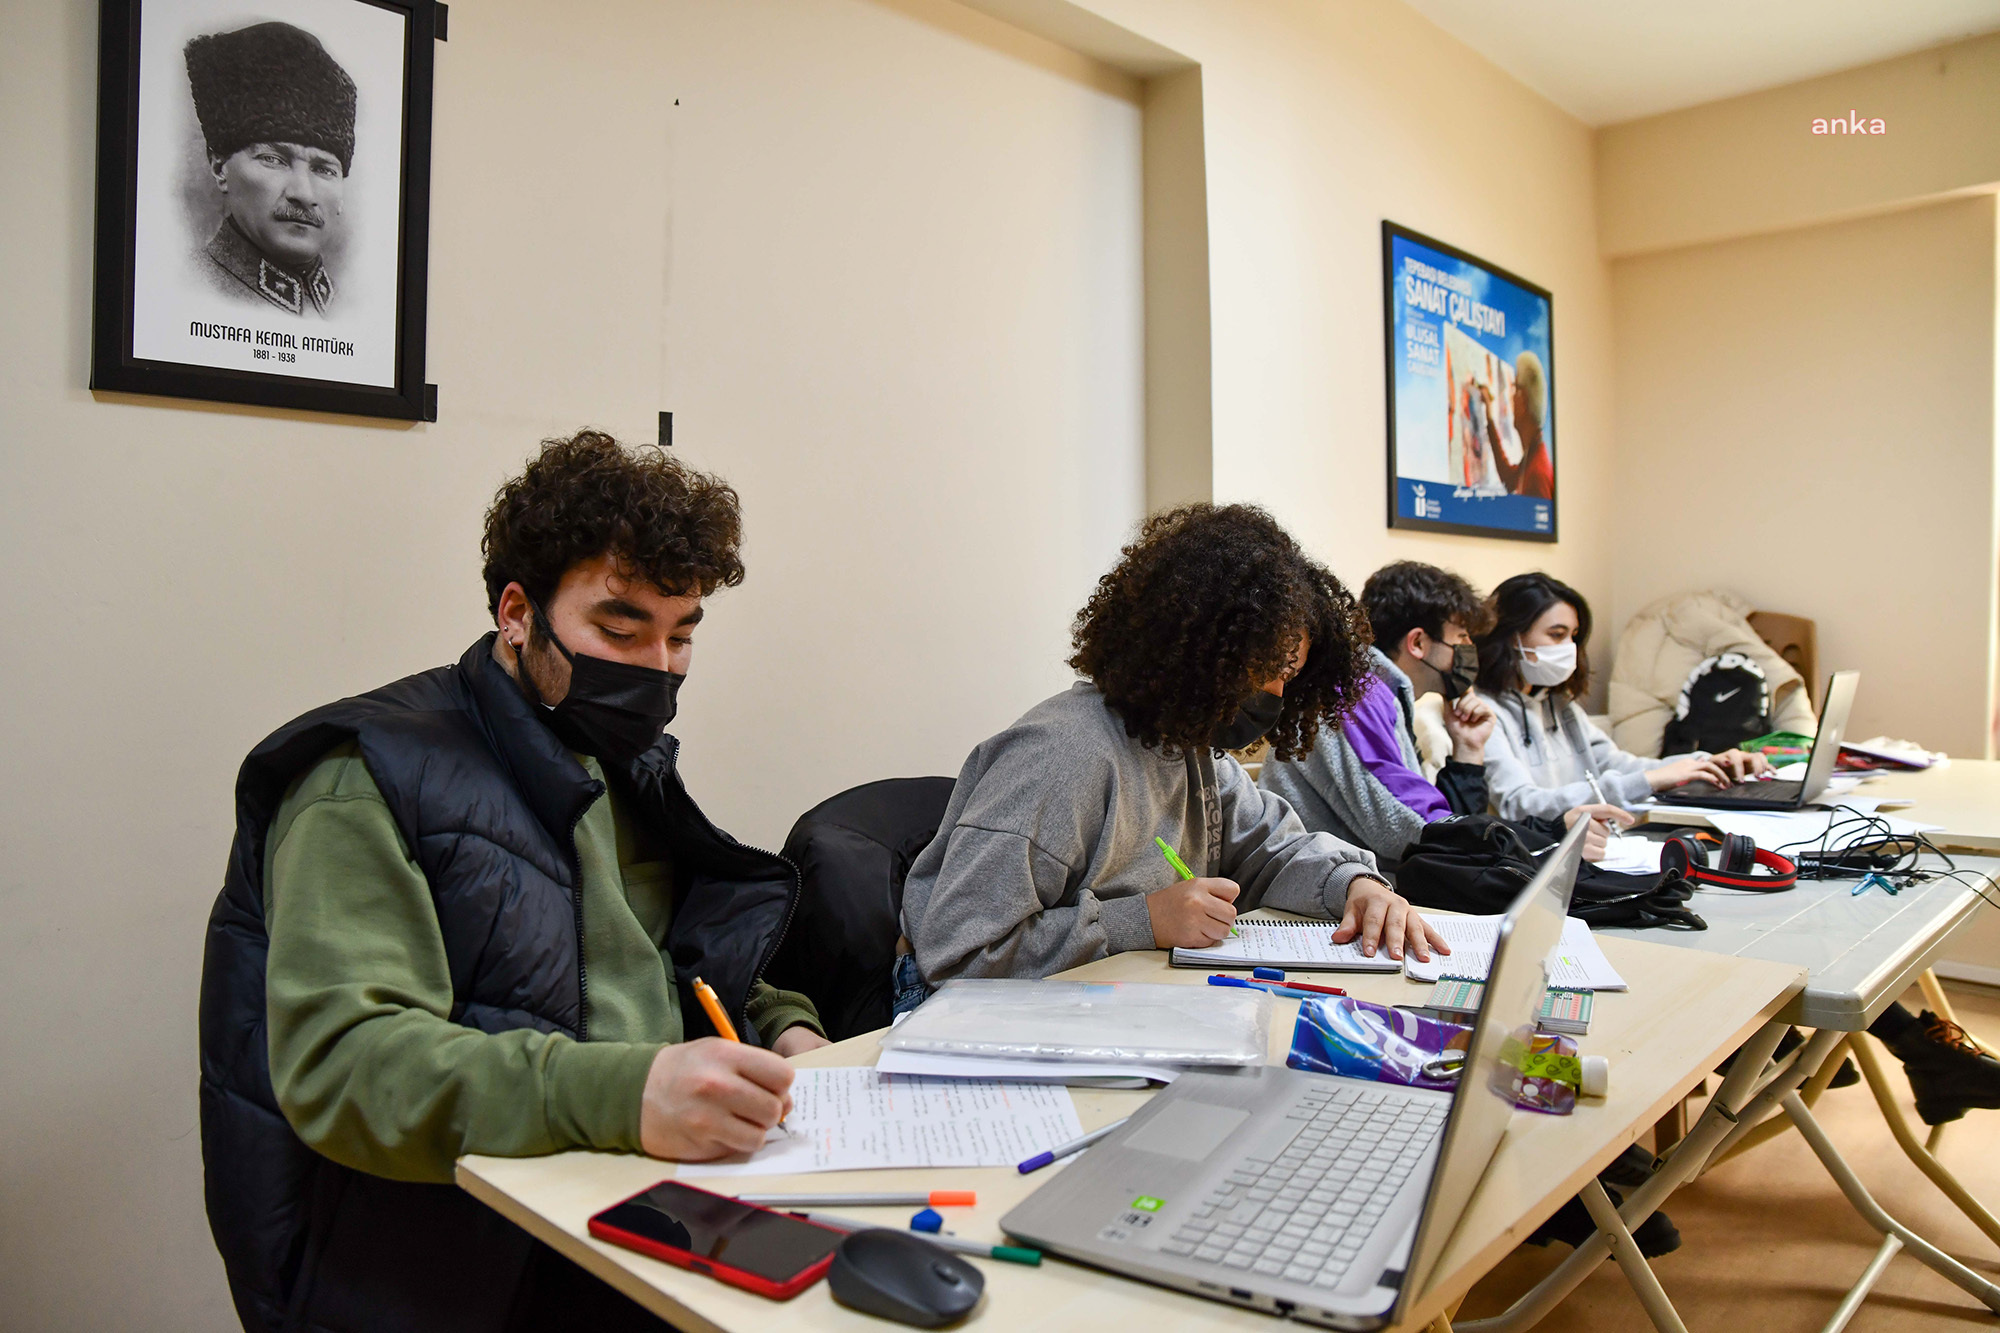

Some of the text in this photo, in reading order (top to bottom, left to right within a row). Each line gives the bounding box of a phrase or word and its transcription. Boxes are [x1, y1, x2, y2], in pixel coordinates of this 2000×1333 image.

[1405, 275, 1448, 317] SANAT
[1449, 293, 1506, 338] ÇALIŞTAYI
[190, 321, 354, 356] MUSTAFA KEMAL ATATÜRK
[1406, 323, 1440, 348] ULUSAL
[253, 349, 270, 360] 1881
[278, 352, 296, 363] 1938
[1407, 340, 1440, 365] SANAT
